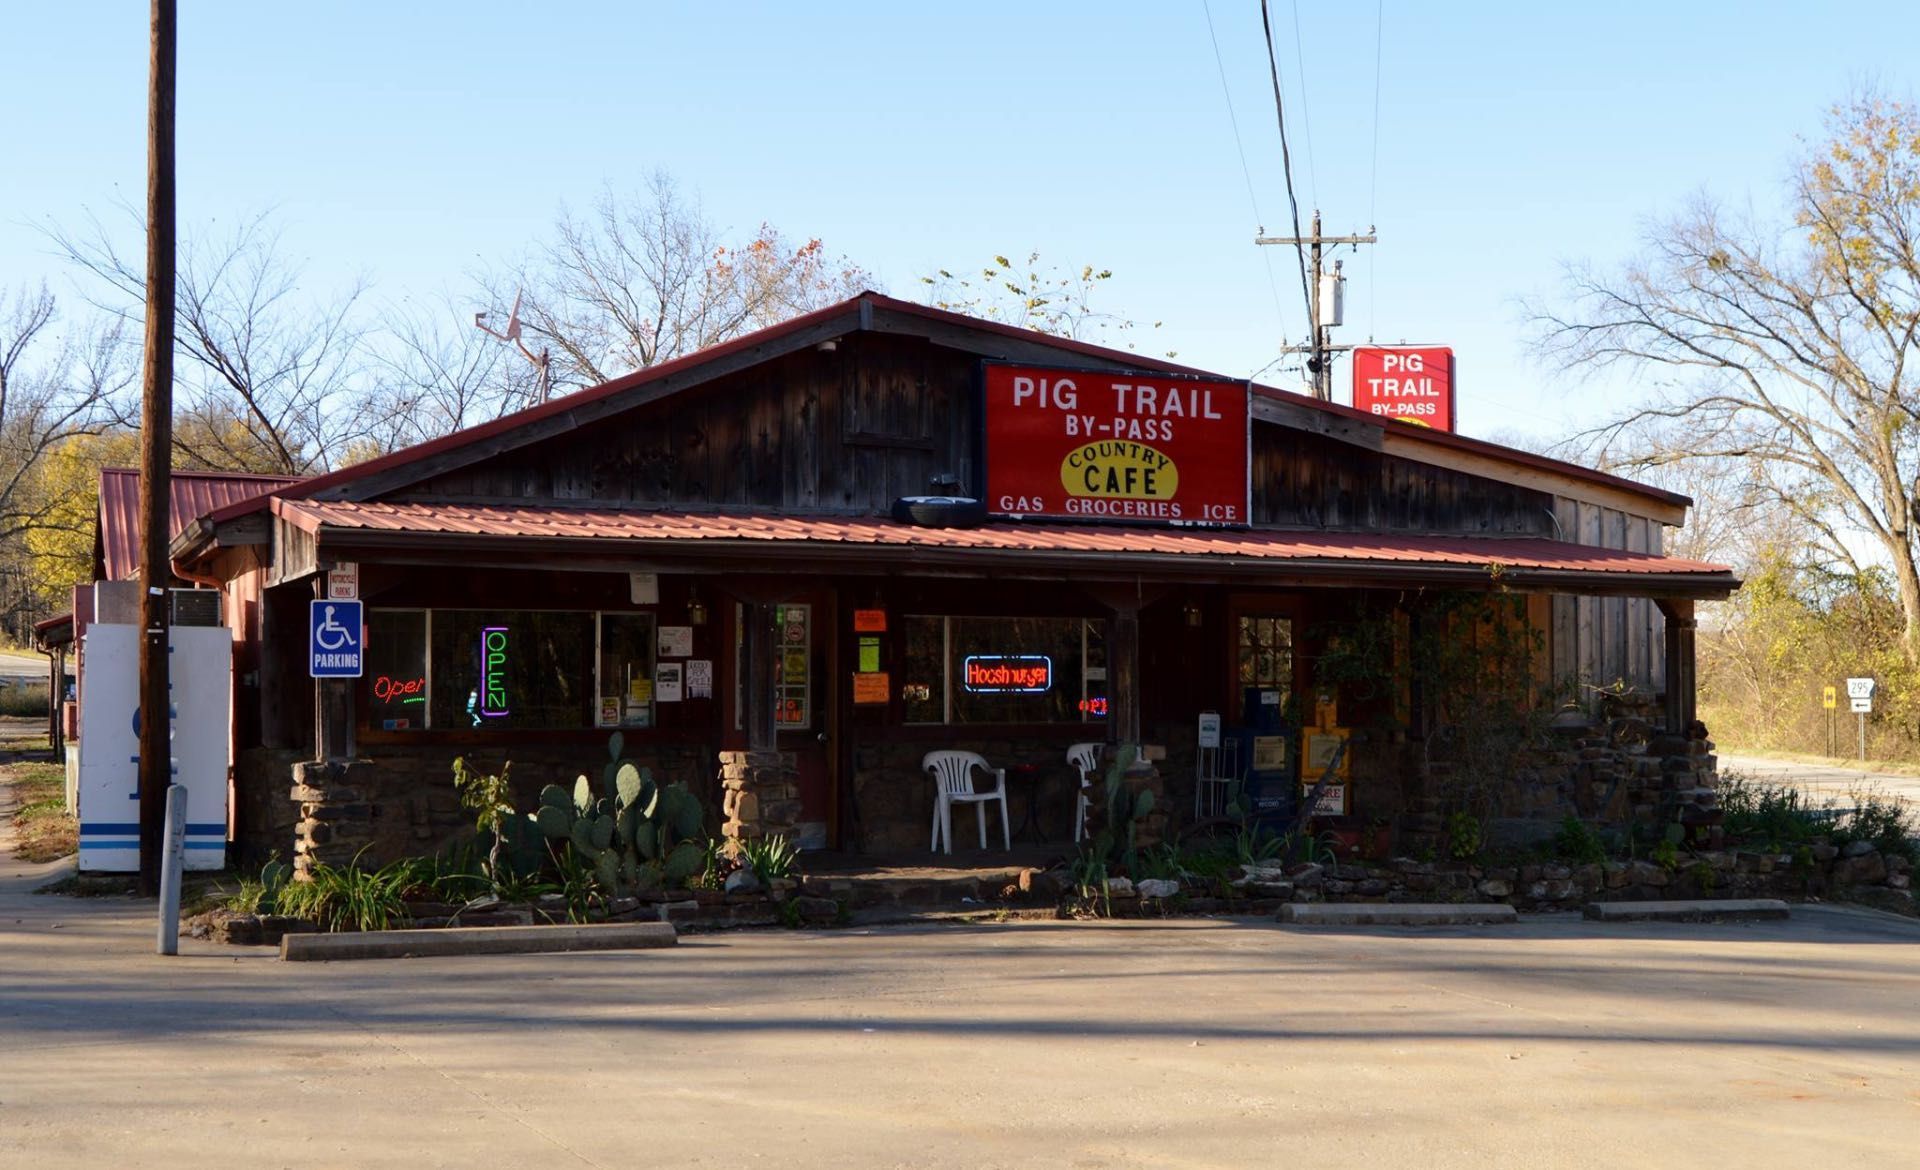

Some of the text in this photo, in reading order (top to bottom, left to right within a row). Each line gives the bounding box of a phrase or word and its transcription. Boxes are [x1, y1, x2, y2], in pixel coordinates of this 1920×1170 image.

[1383, 354, 1424, 373] PIG
[1013, 377, 1221, 420] PIG TRAIL
[1368, 378, 1440, 397] TRAIL
[1371, 403, 1435, 415] BY-PASS
[1066, 414, 1173, 441] BY-PASS
[1069, 443, 1169, 472] COUNTRY
[1084, 465, 1157, 494] CAFE
[1000, 496, 1236, 519] GAS GROCERIES ICE
[314, 654, 358, 668] PARKING
[487, 632, 506, 708] OPEN
[1851, 682, 1868, 694] 295
